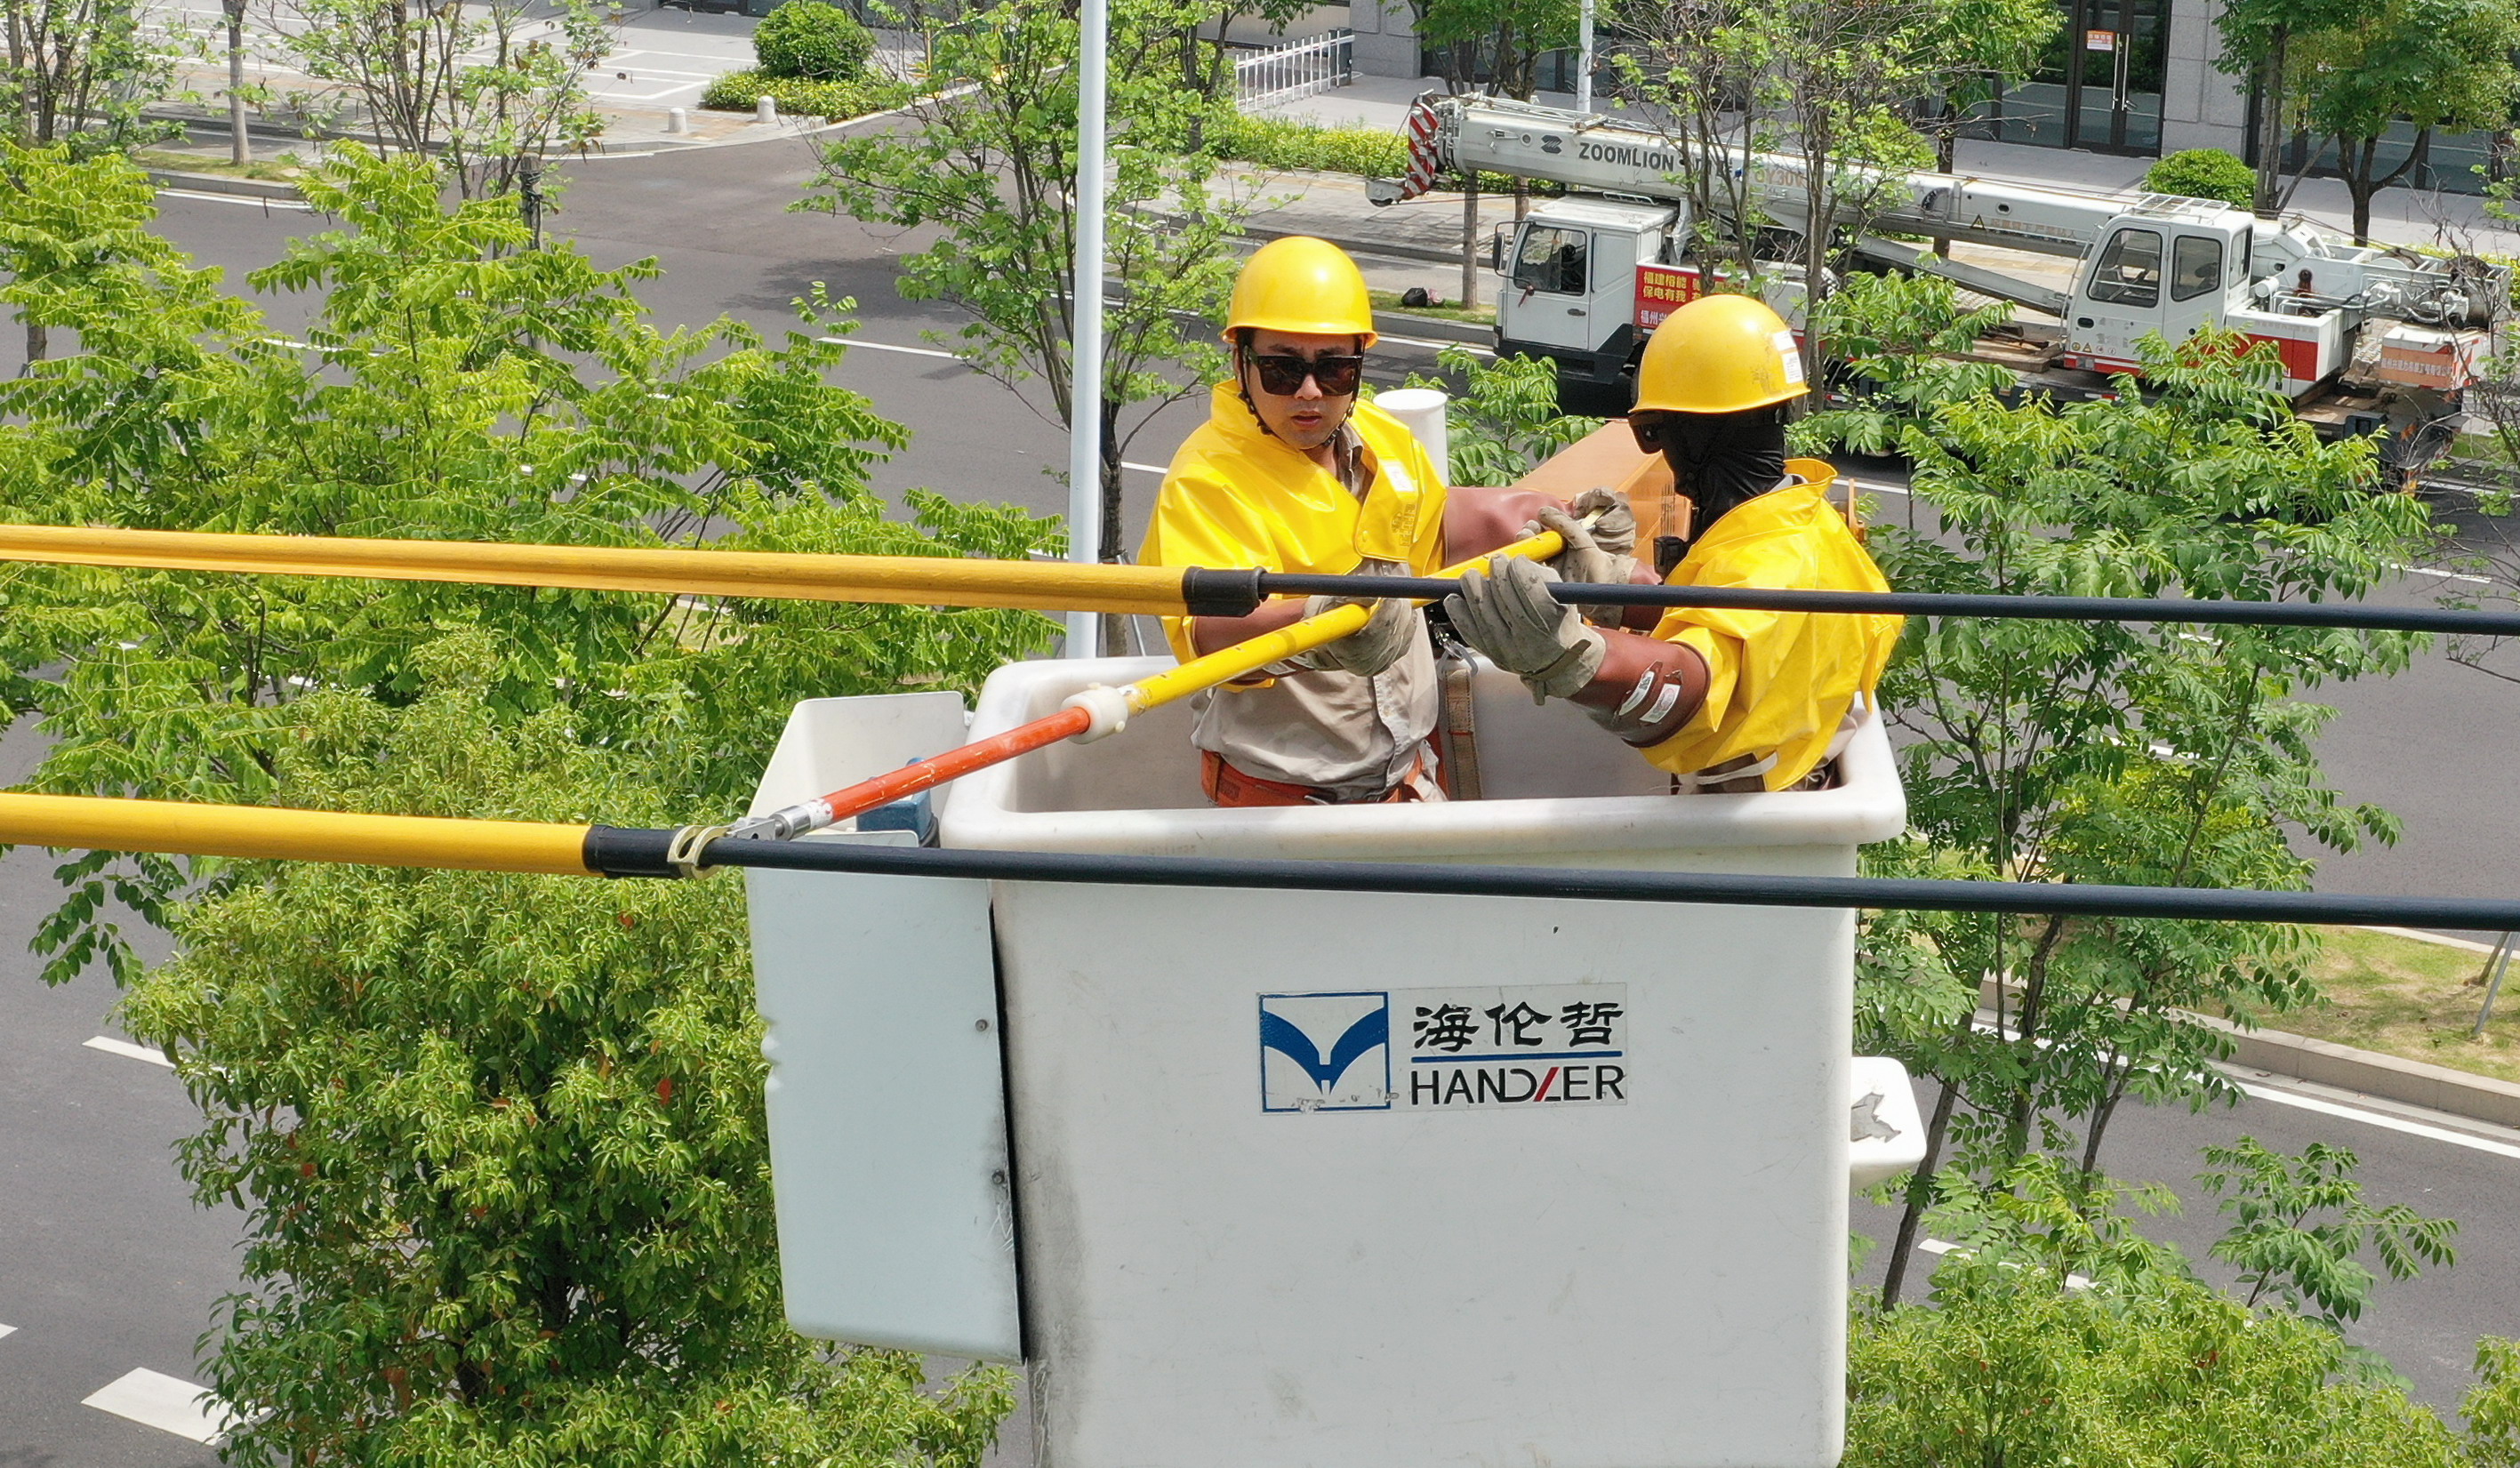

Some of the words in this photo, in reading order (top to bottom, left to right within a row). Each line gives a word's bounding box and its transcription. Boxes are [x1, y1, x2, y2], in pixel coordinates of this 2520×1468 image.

[1579, 142, 1674, 172] ZOOMLION
[1642, 285, 1687, 303] 保电有我
[1643, 271, 1688, 289] 福建榕能
[1411, 1000, 1624, 1053] 海伦哲
[1410, 1064, 1625, 1105] HANDLER
